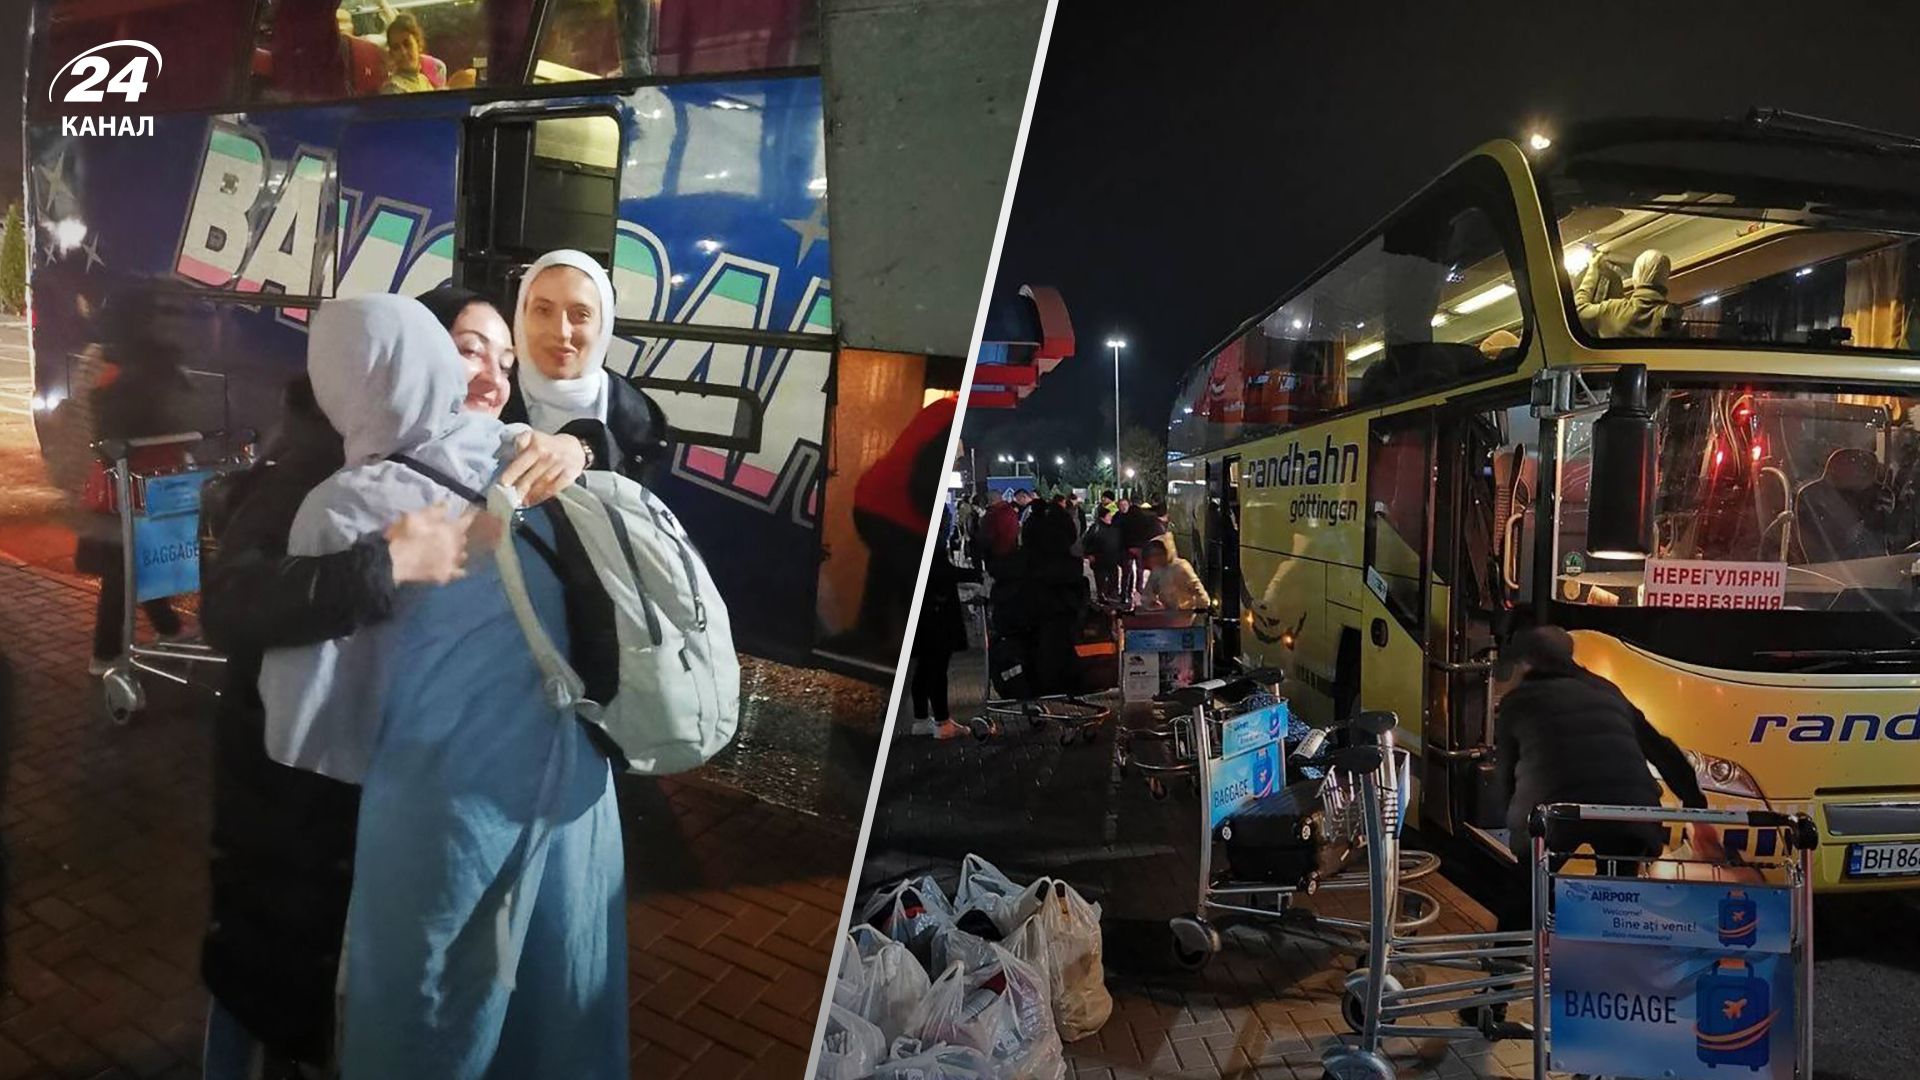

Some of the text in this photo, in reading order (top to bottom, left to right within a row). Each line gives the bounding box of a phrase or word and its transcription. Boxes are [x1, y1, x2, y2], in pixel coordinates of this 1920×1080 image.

[1246, 434, 1360, 489] randhahn
[1289, 493, 1358, 526] göttingen
[141, 540, 201, 567] BAGGAGE
[1652, 566, 1781, 588] НЕРЕГУЛЯРНІ
[1646, 592, 1782, 610] ПЕРЕВЕЗЕННЯ
[1750, 702, 1920, 743] rand
[1214, 778, 1249, 808] BAGGAGE
[1897, 847, 1920, 868] 86
[1590, 890, 1641, 904] AIRPORT
[1613, 917, 1641, 930] Bine
[1661, 921, 1697, 934] venit!
[1564, 989, 1678, 1025] BAGGAGE
